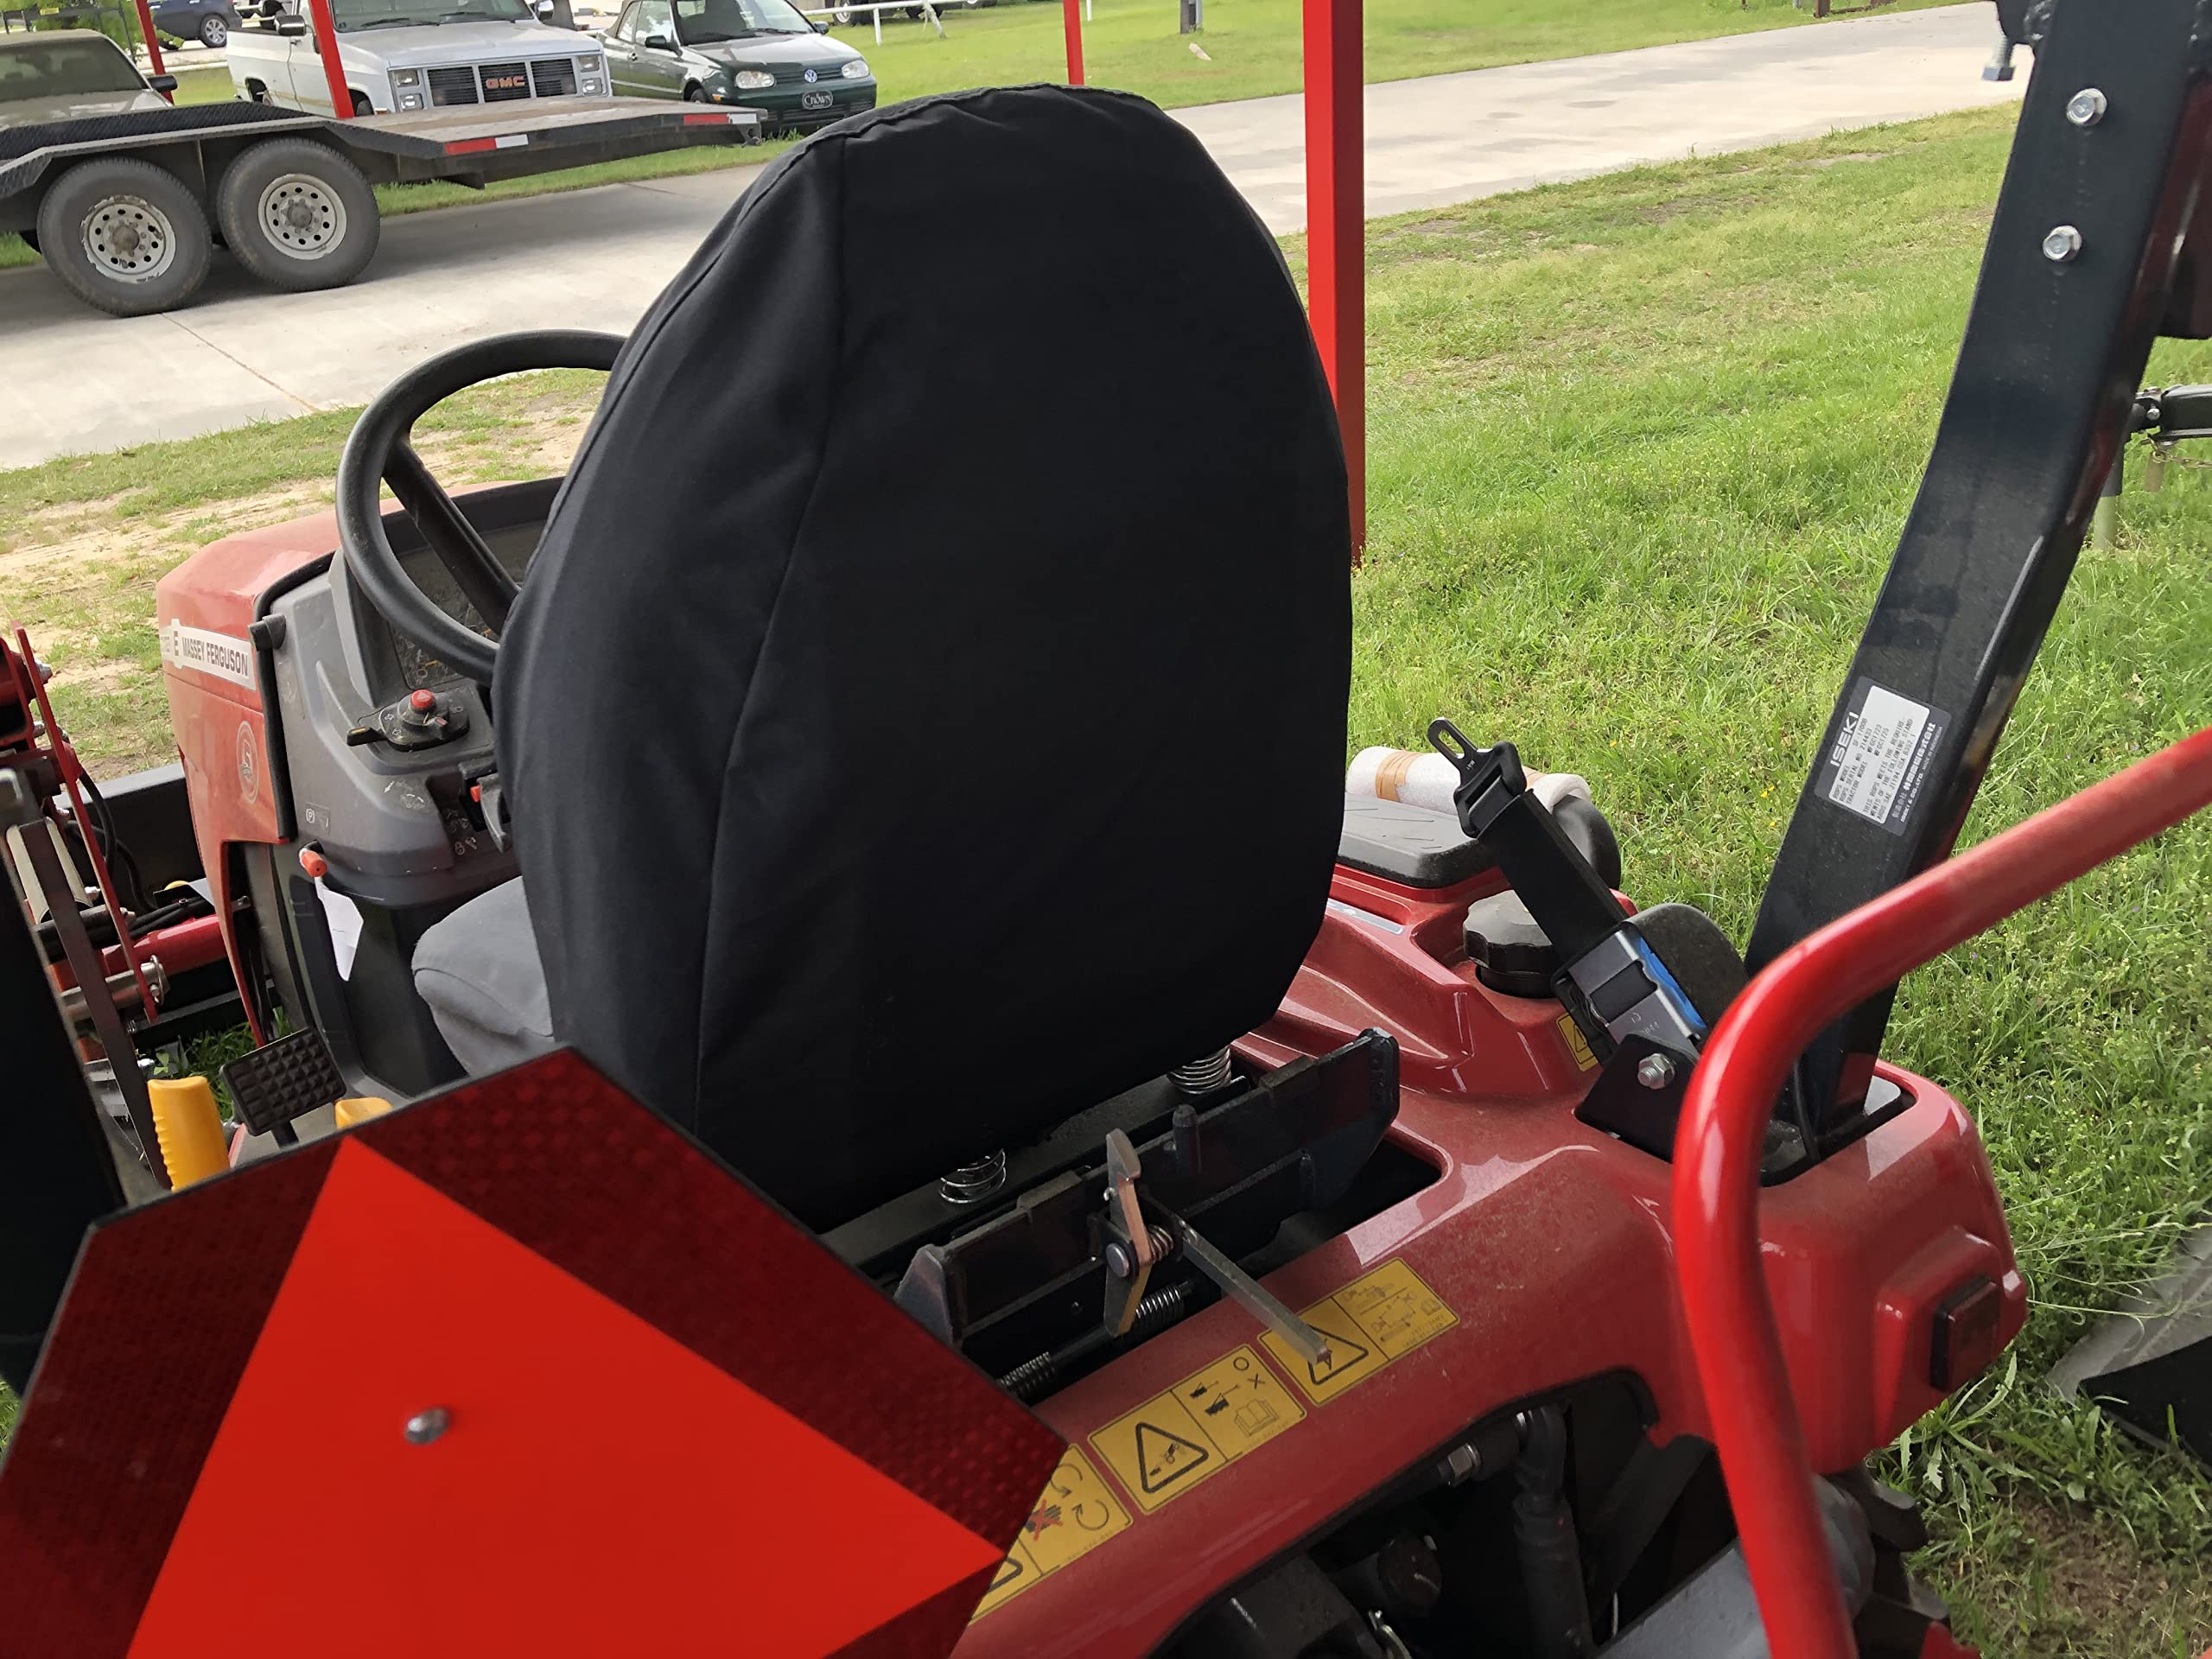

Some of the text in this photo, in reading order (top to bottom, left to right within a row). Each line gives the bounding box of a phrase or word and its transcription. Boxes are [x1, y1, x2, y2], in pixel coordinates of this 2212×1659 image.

[486, 76, 525, 89] GMC
[182, 636, 205, 662] MASSEY
[207, 642, 249, 677] FERGUSON
[1829, 711, 1859, 766] ISEKI
[1887, 739, 1904, 772] FOLLOWING
[1832, 783, 1841, 798] ROPS
[1839, 765, 1849, 781] MODEL
[1839, 786, 1848, 802] ROPS
[1846, 764, 1857, 785] SERIAL
[1846, 779, 1859, 804] TRACTOR
[1857, 760, 1867, 778] MODEL
[1863, 798, 1872, 813] THIS
[1869, 781, 1879, 797] ROPS
[1876, 760, 1888, 779] MEETS
[1883, 792, 1891, 803] SAE
